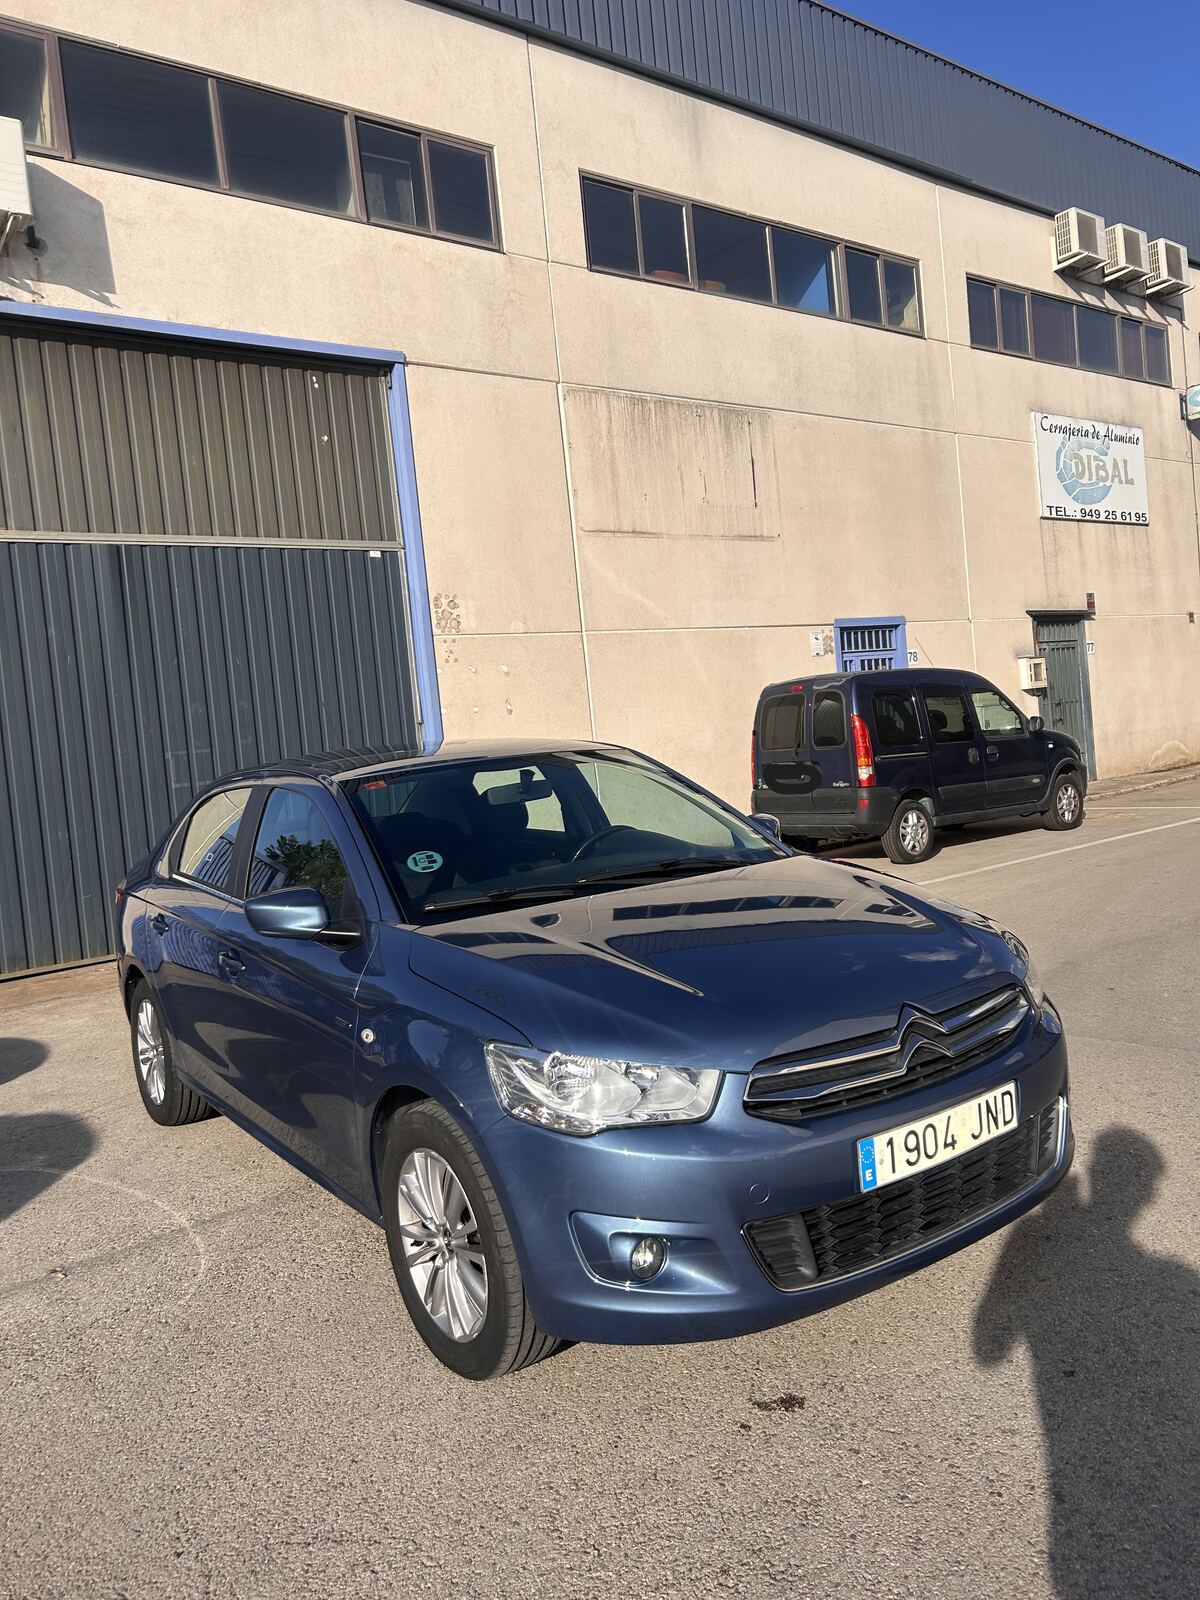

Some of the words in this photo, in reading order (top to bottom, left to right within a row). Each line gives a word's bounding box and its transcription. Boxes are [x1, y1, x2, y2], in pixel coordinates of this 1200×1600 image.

[1091, 424, 1101, 440] de
[1103, 426, 1140, 445] Aluminio
[1071, 452, 1134, 485] DIBAL
[1046, 505, 1077, 518] TEL.:
[1080, 508, 1101, 519] 949
[1104, 510, 1118, 521] 25
[1086, 642, 1094, 653] 77
[908, 651, 919, 663] 78
[865, 1168, 874, 1182] E
[886, 1115, 958, 1174] 1904
[971, 1090, 1015, 1140] JND
